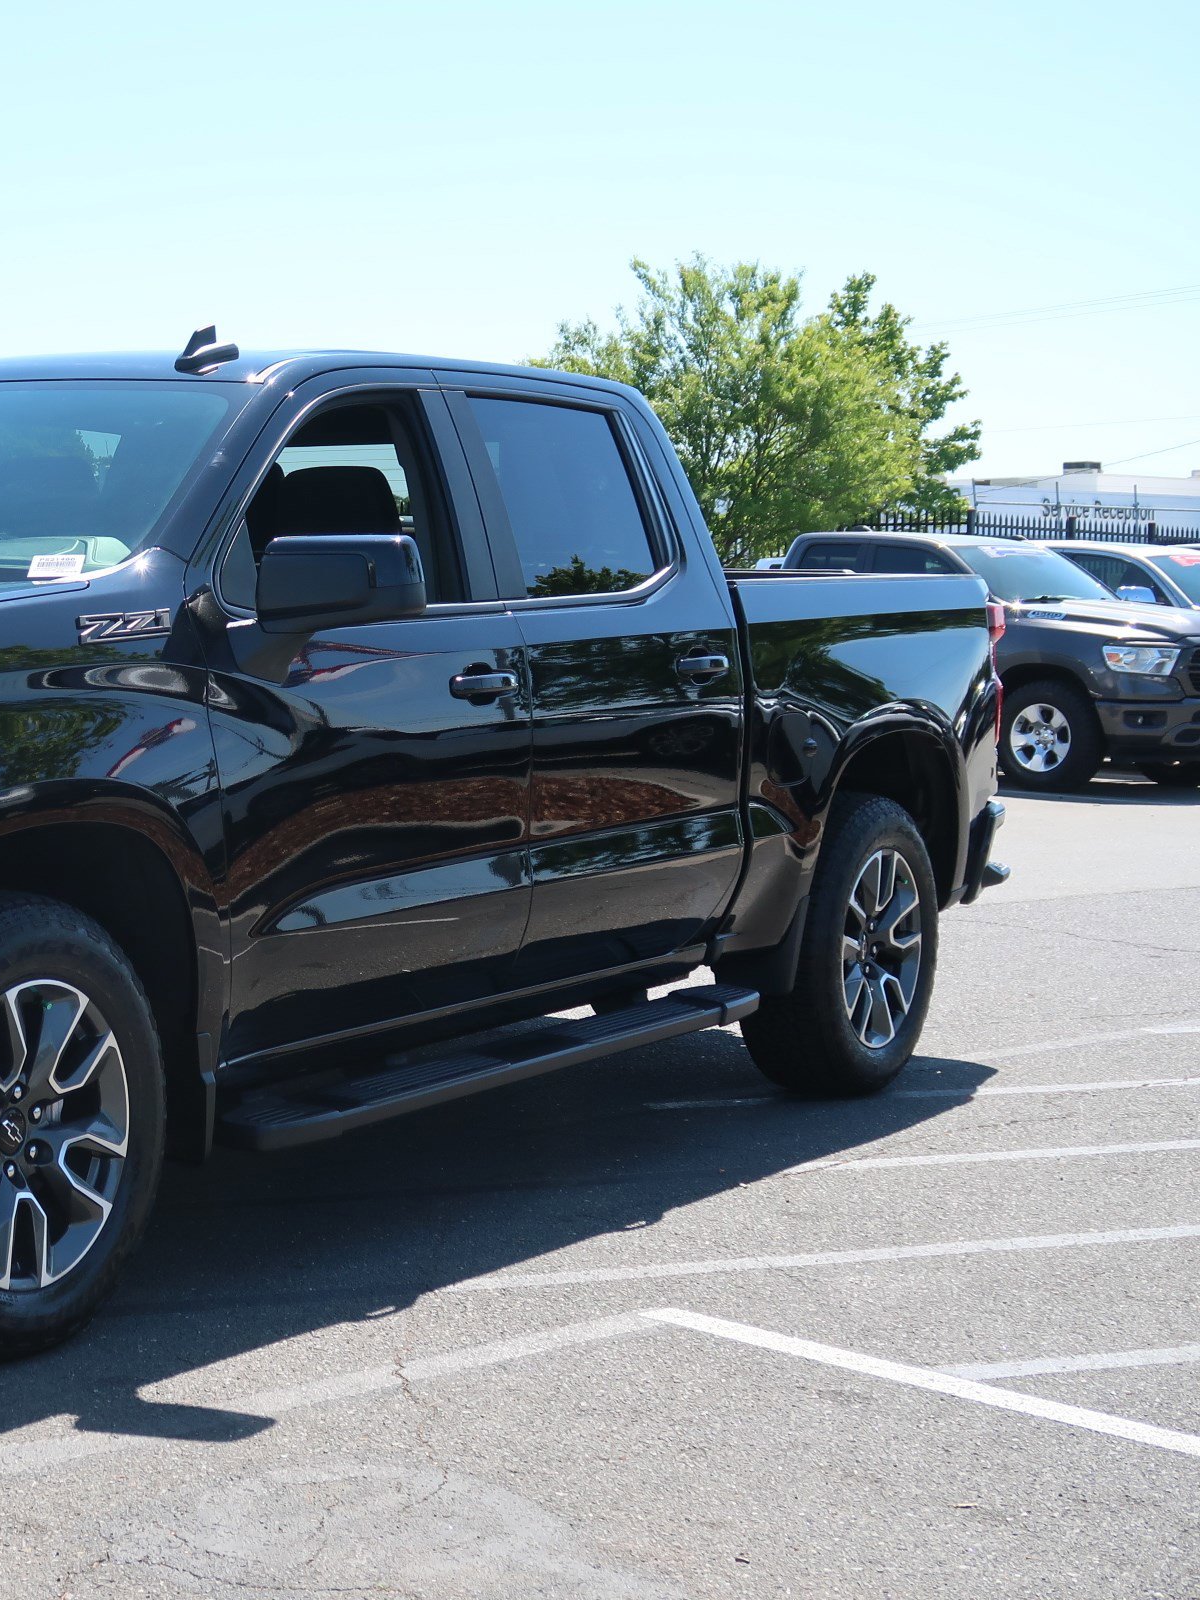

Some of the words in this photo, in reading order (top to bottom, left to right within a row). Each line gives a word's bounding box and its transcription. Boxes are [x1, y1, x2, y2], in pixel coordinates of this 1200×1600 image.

[1042, 498, 1090, 518] Service
[1093, 500, 1155, 522] Reception
[75, 607, 172, 645] Z71
